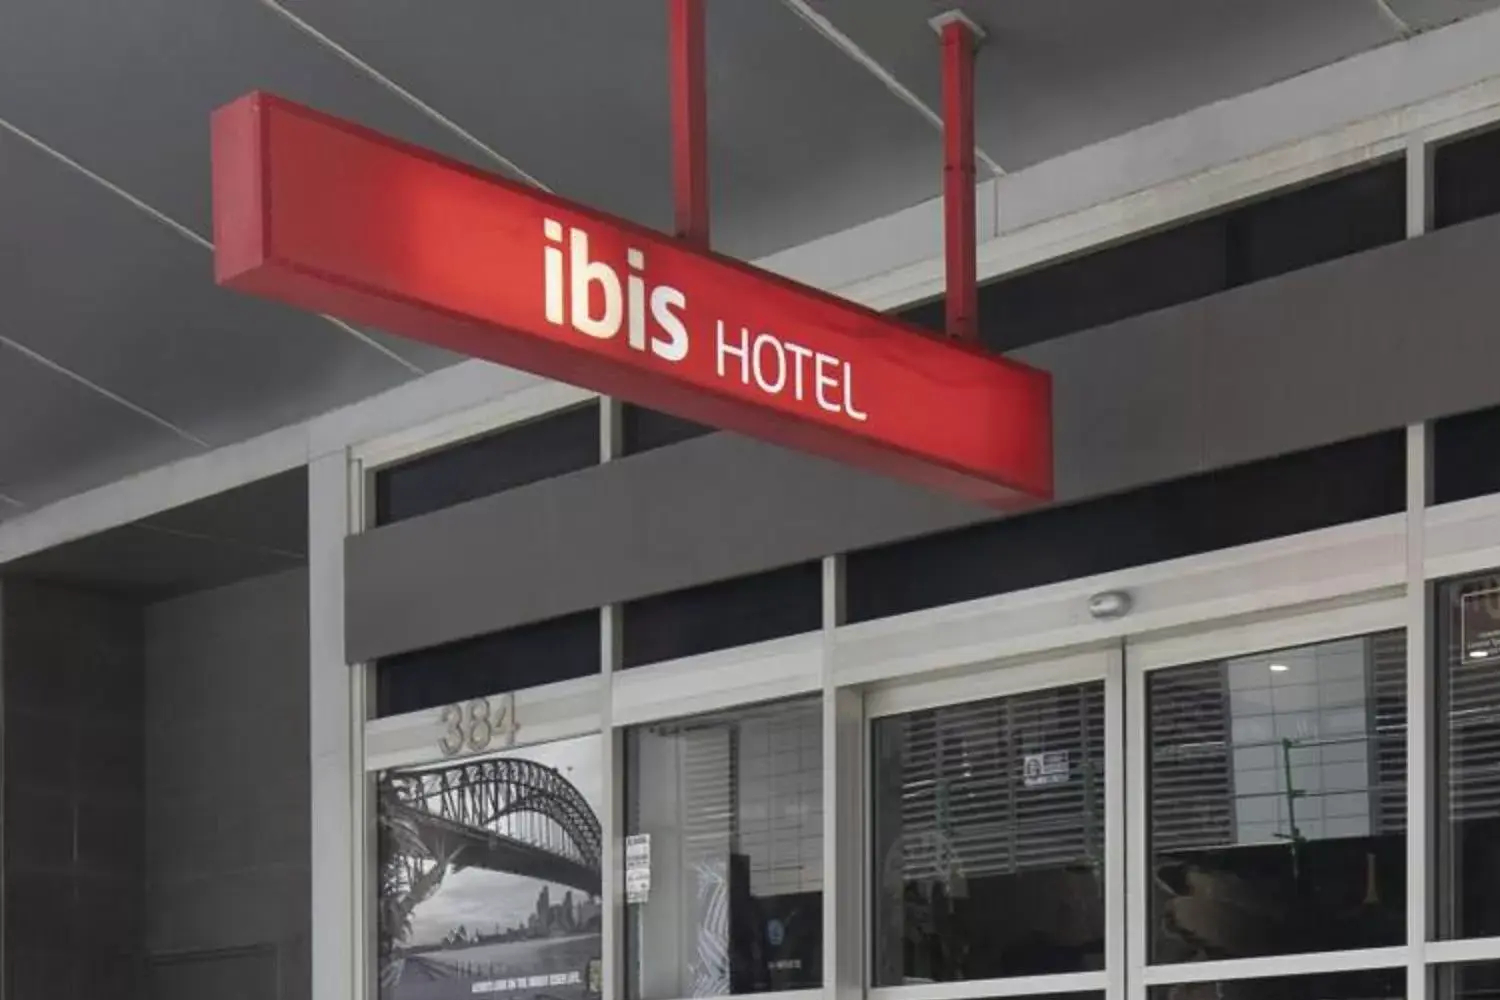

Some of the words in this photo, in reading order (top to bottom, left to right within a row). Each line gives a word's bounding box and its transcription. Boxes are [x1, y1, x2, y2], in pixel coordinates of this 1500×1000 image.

[542, 217, 689, 362] ibis
[714, 319, 868, 422] HOTEL
[438, 692, 515, 756] 384
